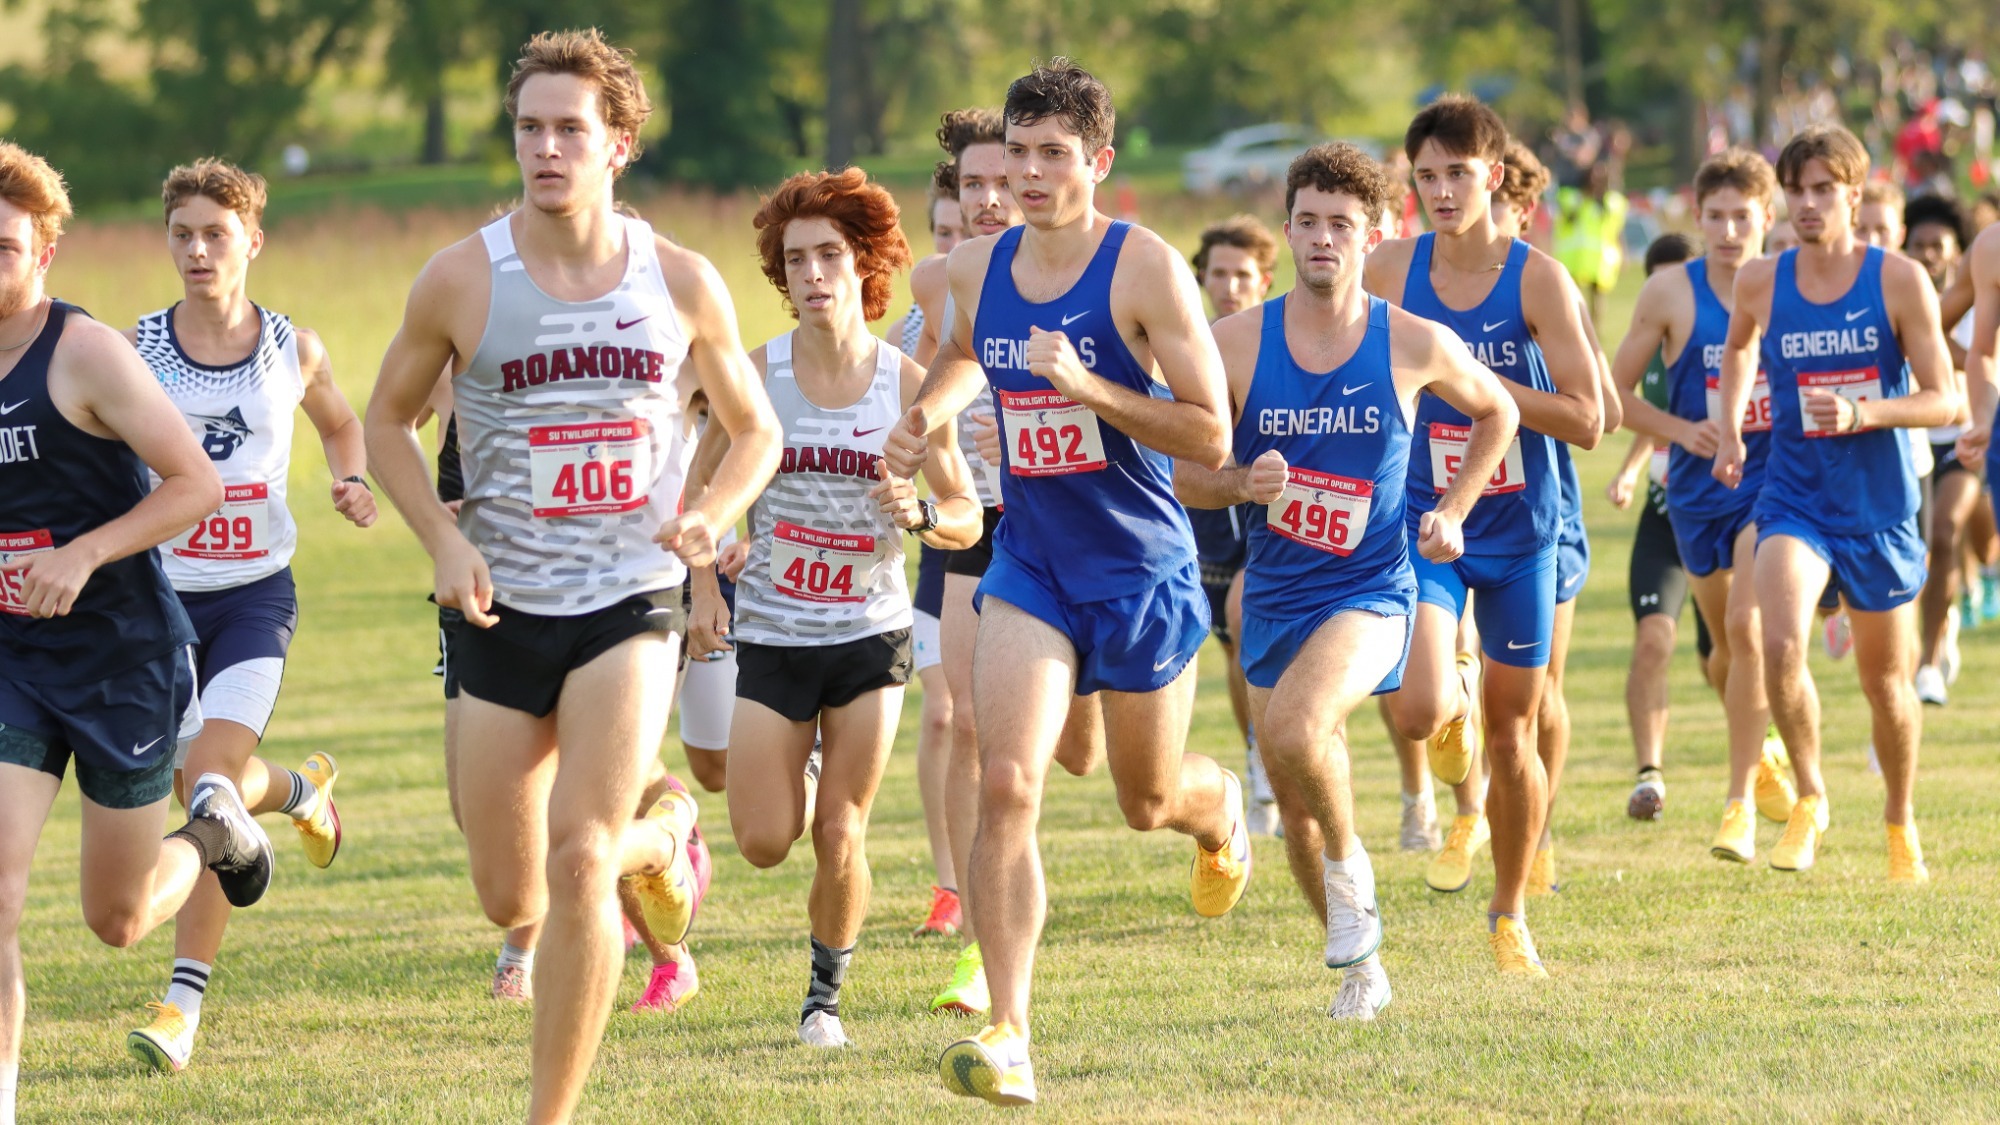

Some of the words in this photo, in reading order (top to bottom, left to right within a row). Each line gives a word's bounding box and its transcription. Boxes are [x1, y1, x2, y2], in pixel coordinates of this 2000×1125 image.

[983, 336, 1097, 370] GENS
[1781, 326, 1879, 359] GENERALS
[501, 346, 665, 393] ROANOKE
[1015, 395, 1047, 406] TWILIGHT
[548, 432, 559, 441] SU
[561, 428, 600, 440] TWILIGHT
[601, 427, 633, 437] OPENER
[1258, 406, 1380, 436] GENERALS
[1018, 424, 1088, 466] 492
[776, 447, 884, 482] OANOK
[1445, 455, 1508, 486] 50
[228, 488, 253, 498] OPENER
[552, 460, 633, 504] 406
[1297, 473, 1330, 486] TWILIGHT
[1330, 480, 1357, 492] OPENER
[188, 516, 252, 550] 299
[789, 529, 799, 538] SU
[800, 532, 831, 545] TWILIGHT
[832, 538, 858, 548] OPENER
[1281, 500, 1351, 546] 496
[8, 537, 35, 547] OPENER
[783, 556, 854, 595] 404
